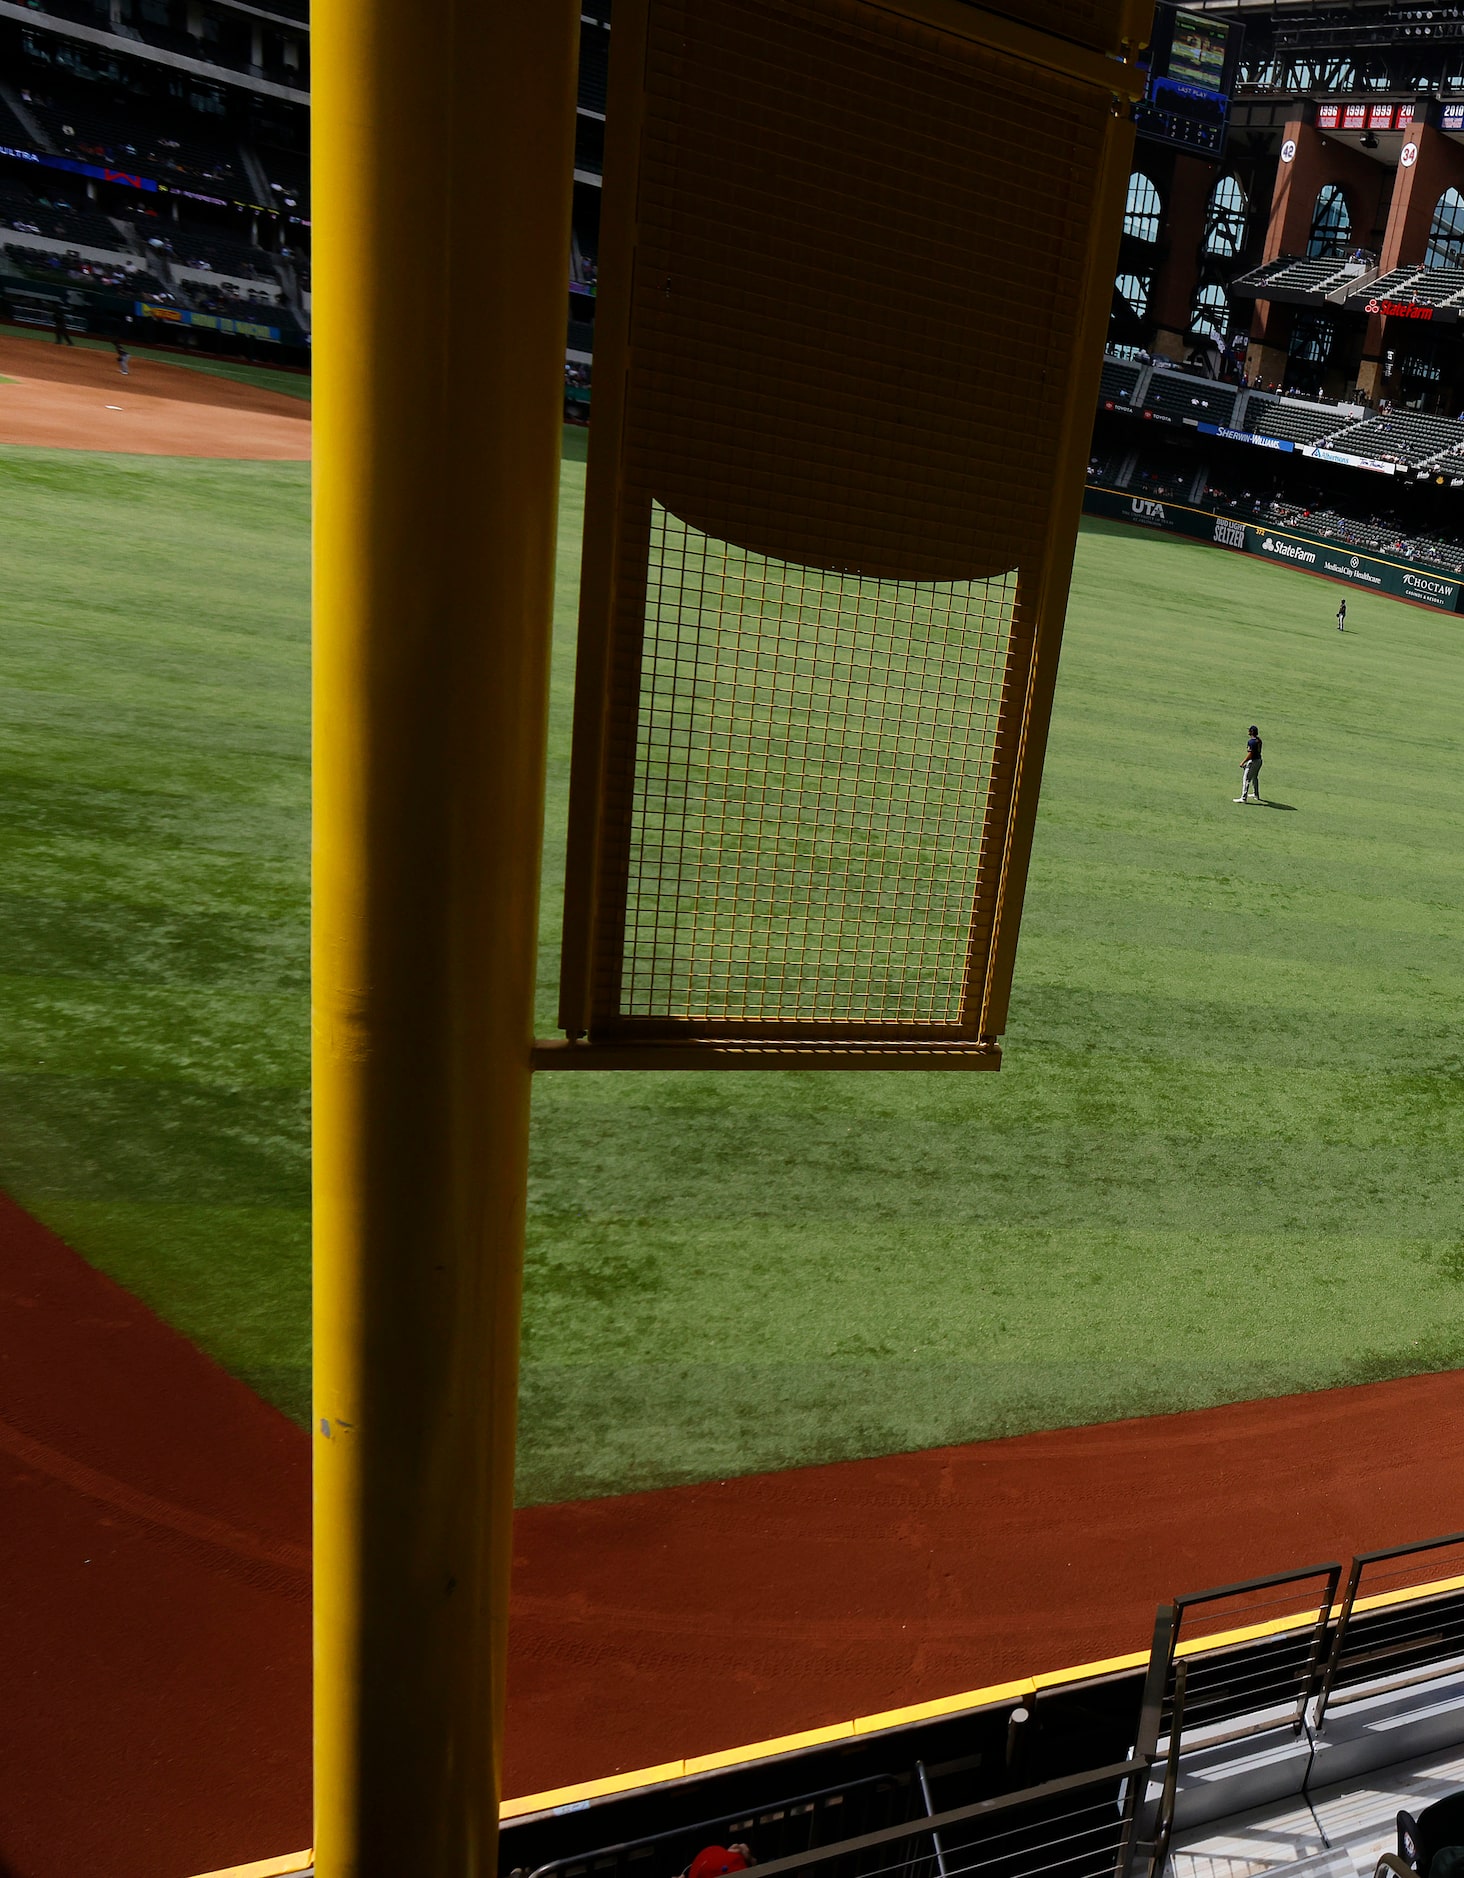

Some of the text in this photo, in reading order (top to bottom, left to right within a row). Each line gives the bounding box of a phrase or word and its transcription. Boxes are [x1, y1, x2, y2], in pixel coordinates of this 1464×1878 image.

[1319, 105, 1338, 117] 1996
[1346, 105, 1365, 117] 1998
[1372, 105, 1392, 117] 1999
[1444, 105, 1464, 117] 2010
[1282, 145, 1295, 158] 42
[1402, 148, 1416, 162] 34
[1114, 404, 1133, 413] TOYOTA
[1152, 413, 1172, 422] TOYOTA
[1131, 498, 1165, 519] UTA
[1216, 518, 1247, 532] BUD LIGHT
[1213, 525, 1245, 549] SELTZER
[1353, 569, 1382, 584] Healthcare
[1407, 574, 1453, 596] CHOCTAW
